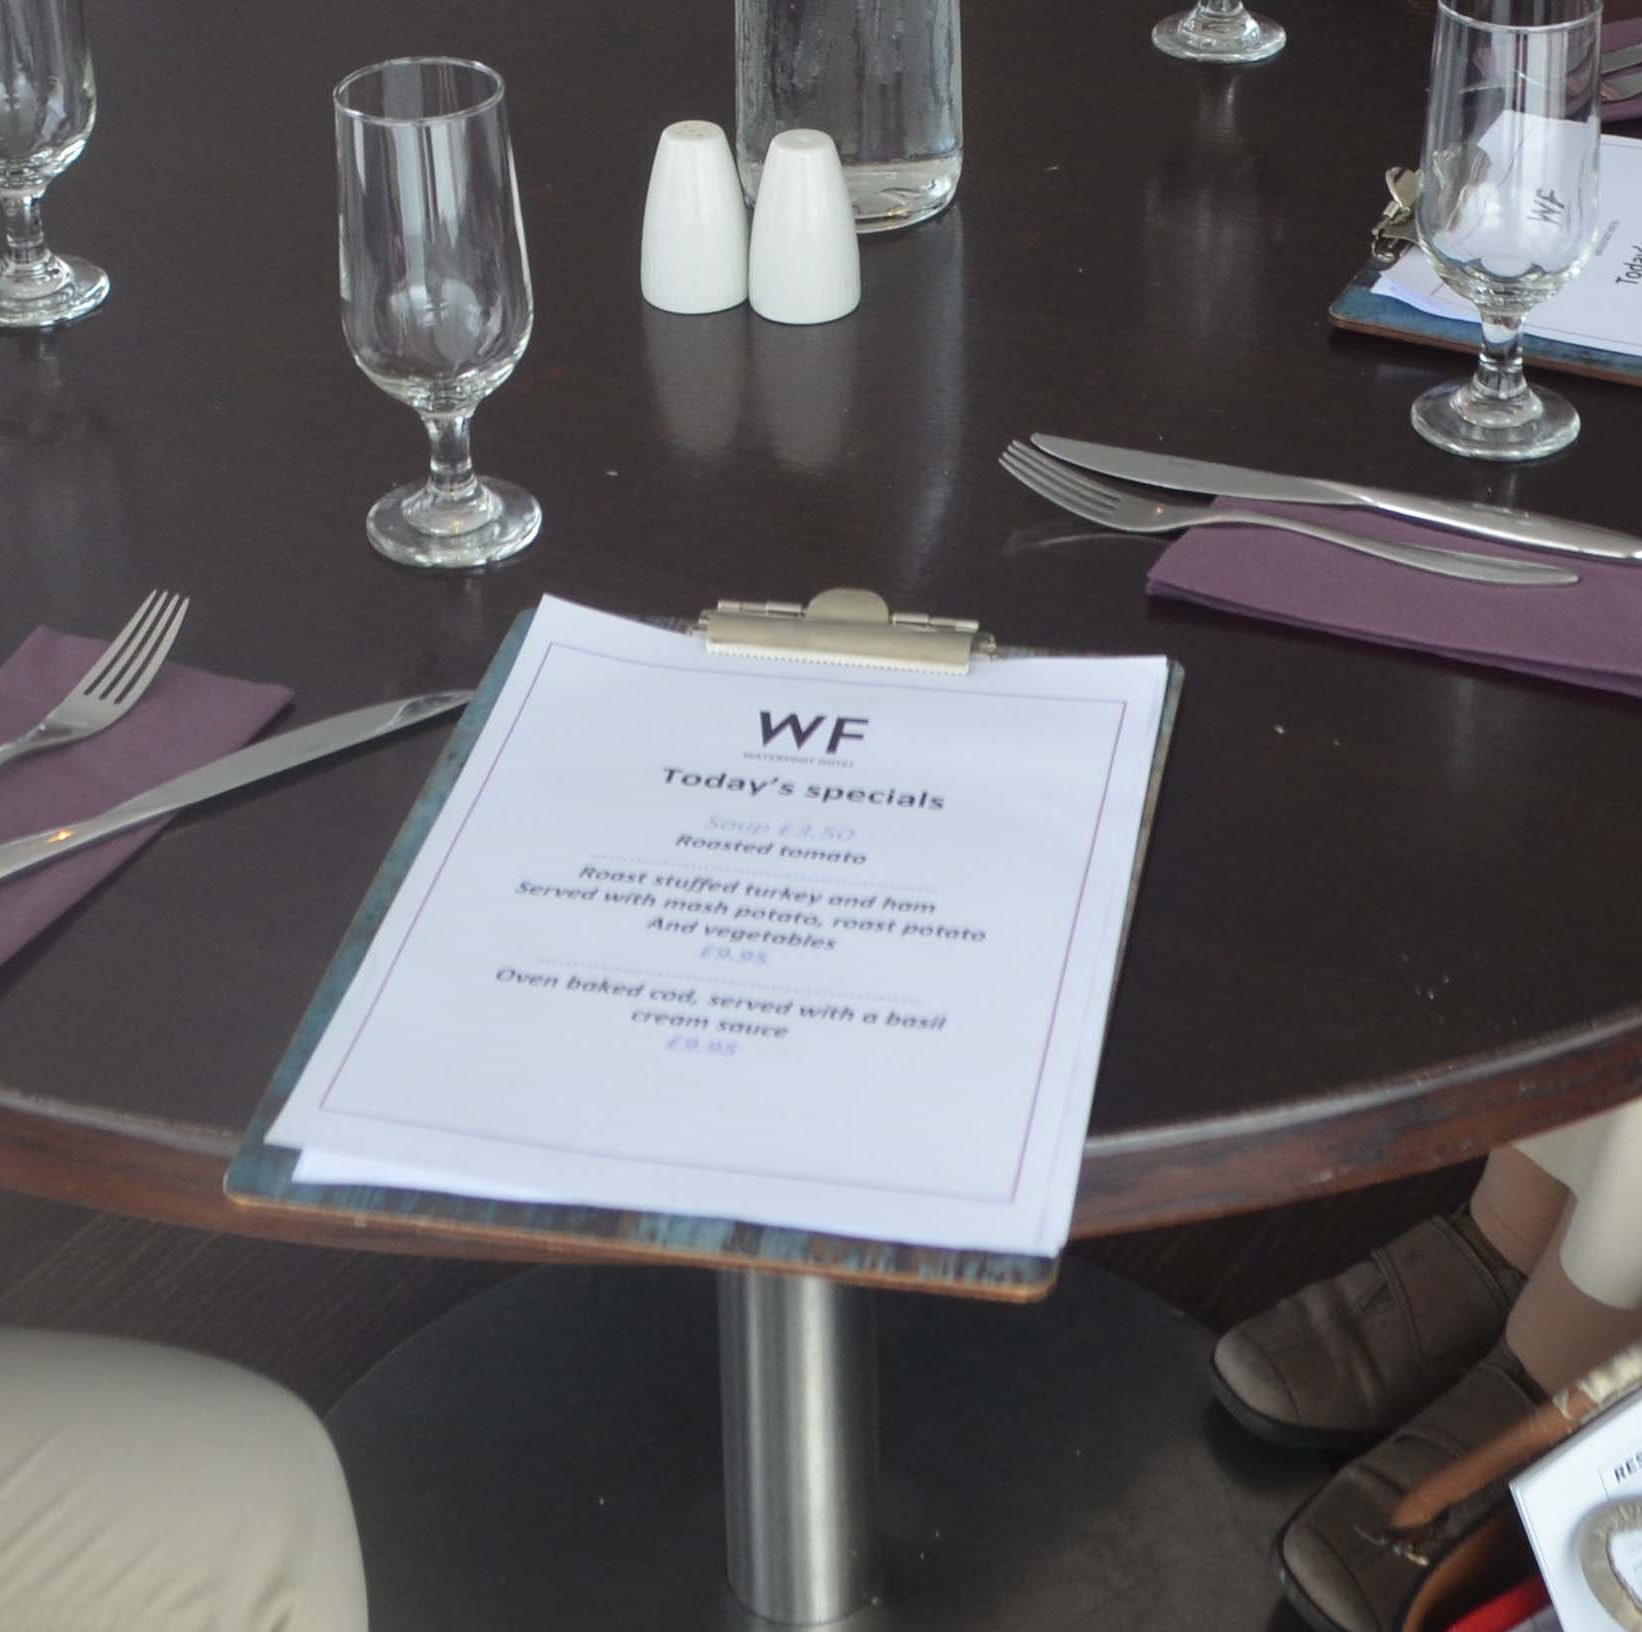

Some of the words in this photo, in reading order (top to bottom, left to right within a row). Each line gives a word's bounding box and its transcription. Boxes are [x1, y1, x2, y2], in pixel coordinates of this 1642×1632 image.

[759, 710, 870, 754] WF
[662, 767, 796, 796] Today's
[806, 783, 945, 811] specials
[675, 834, 773, 855] Roasted
[780, 845, 867, 865] tomato
[514, 881, 599, 901] Served
[604, 890, 657, 908] with
[663, 898, 729, 915] mash
[734, 905, 822, 928] potato,
[832, 916, 897, 934] roast
[901, 924, 987, 943] potato
[579, 866, 647, 884] Roast
[653, 875, 741, 894] stuffed
[745, 883, 822, 906] turkey
[828, 894, 878, 910] and
[882, 897, 936, 915] ham
[646, 916, 698, 934] And
[704, 923, 837, 950] vegetables
[496, 968, 559, 988] Oven
[566, 976, 645, 998] baked
[649, 989, 698, 1006] cod,
[709, 994, 793, 1016] served
[799, 1004, 854, 1022] with
[862, 1012, 879, 1025] a
[885, 1011, 948, 1031] basil
[630, 1009, 709, 1030] cream
[717, 1019, 789, 1039] sauce
